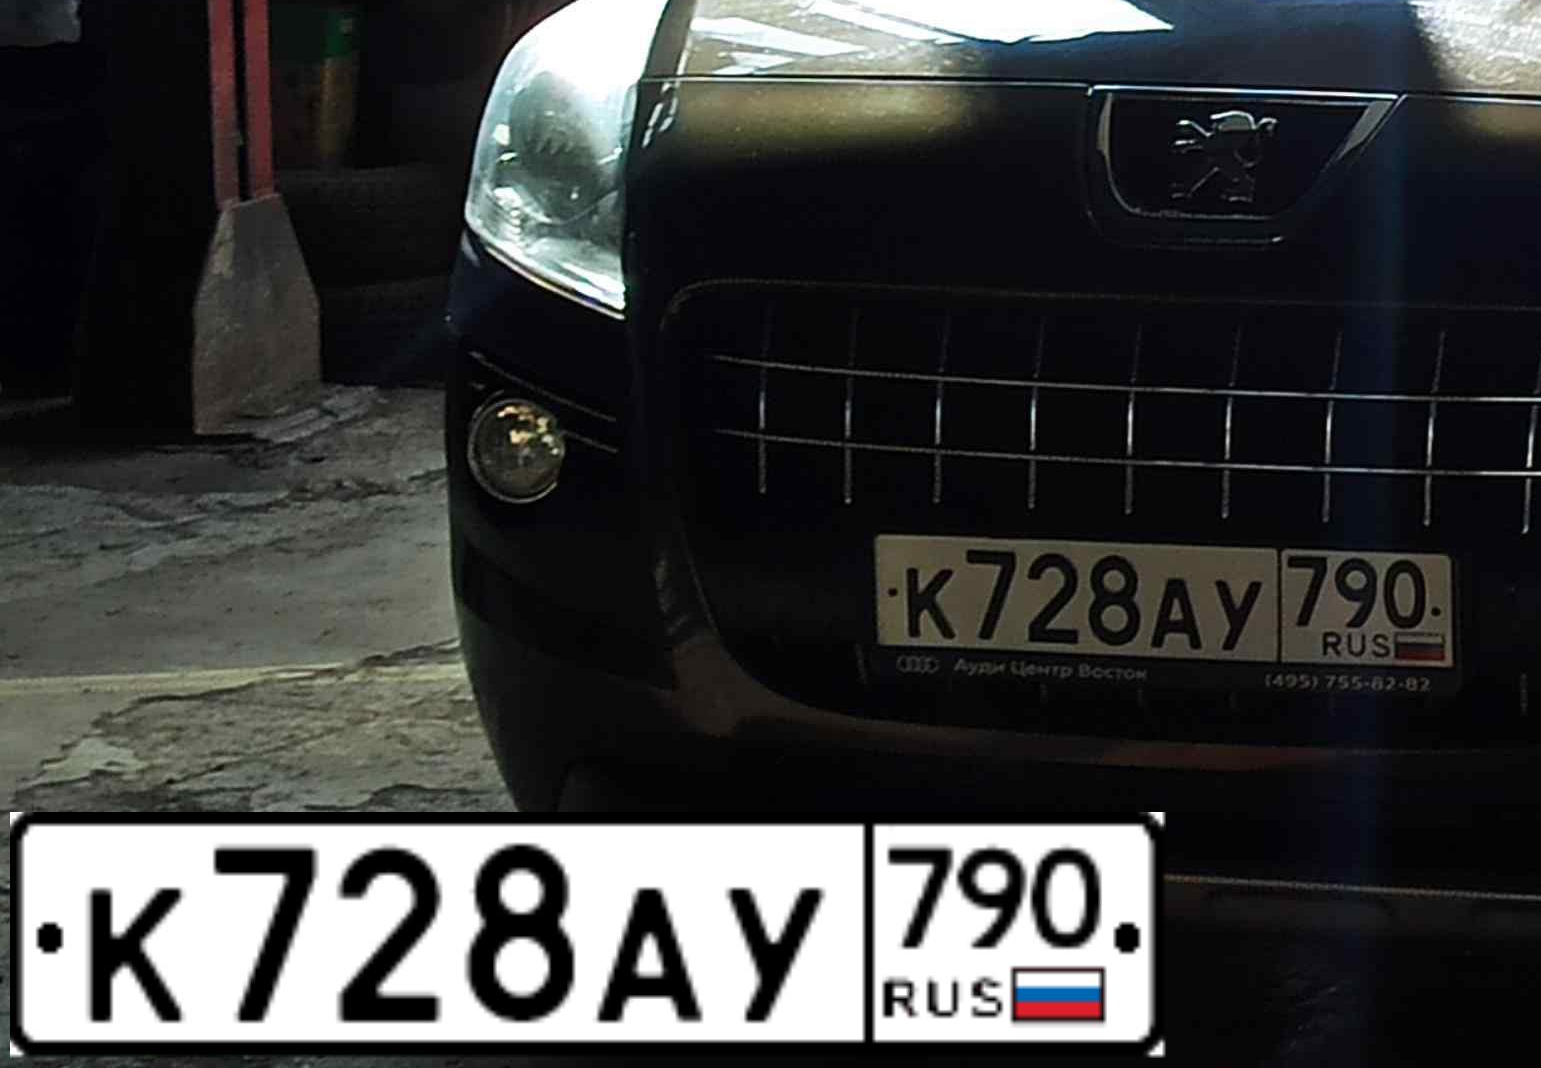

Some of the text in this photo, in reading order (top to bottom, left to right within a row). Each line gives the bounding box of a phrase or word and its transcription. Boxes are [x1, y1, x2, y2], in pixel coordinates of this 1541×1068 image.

[1286, 556, 1428, 630] 790
[1322, 632, 1392, 660] RUS
[953, 656, 1149, 681] Ауди Центр Восток
[1264, 673, 1433, 692] (495) 755-82-82
